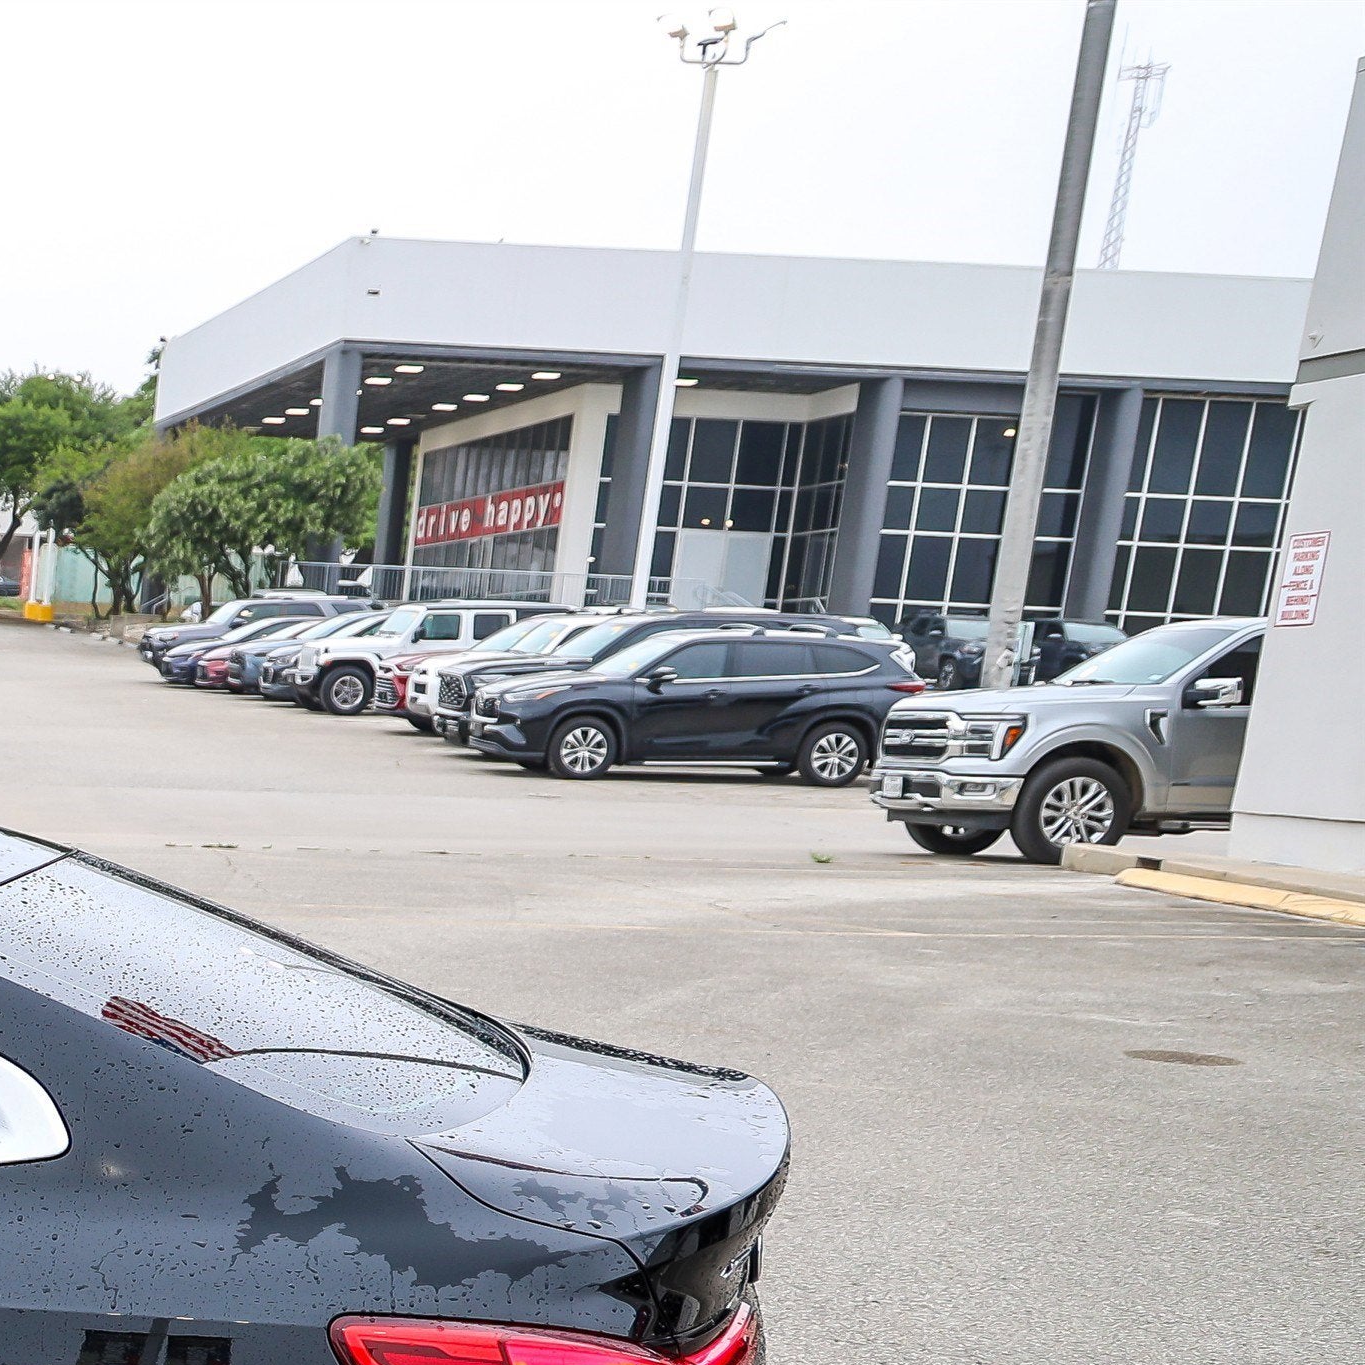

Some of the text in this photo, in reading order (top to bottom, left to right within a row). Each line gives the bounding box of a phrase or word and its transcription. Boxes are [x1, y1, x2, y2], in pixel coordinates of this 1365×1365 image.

[417, 493, 551, 538] drive happy
[1293, 550, 1320, 562] PARKING
[1292, 564, 1314, 576] ALONG
[1281, 609, 1310, 621] BUILDING
